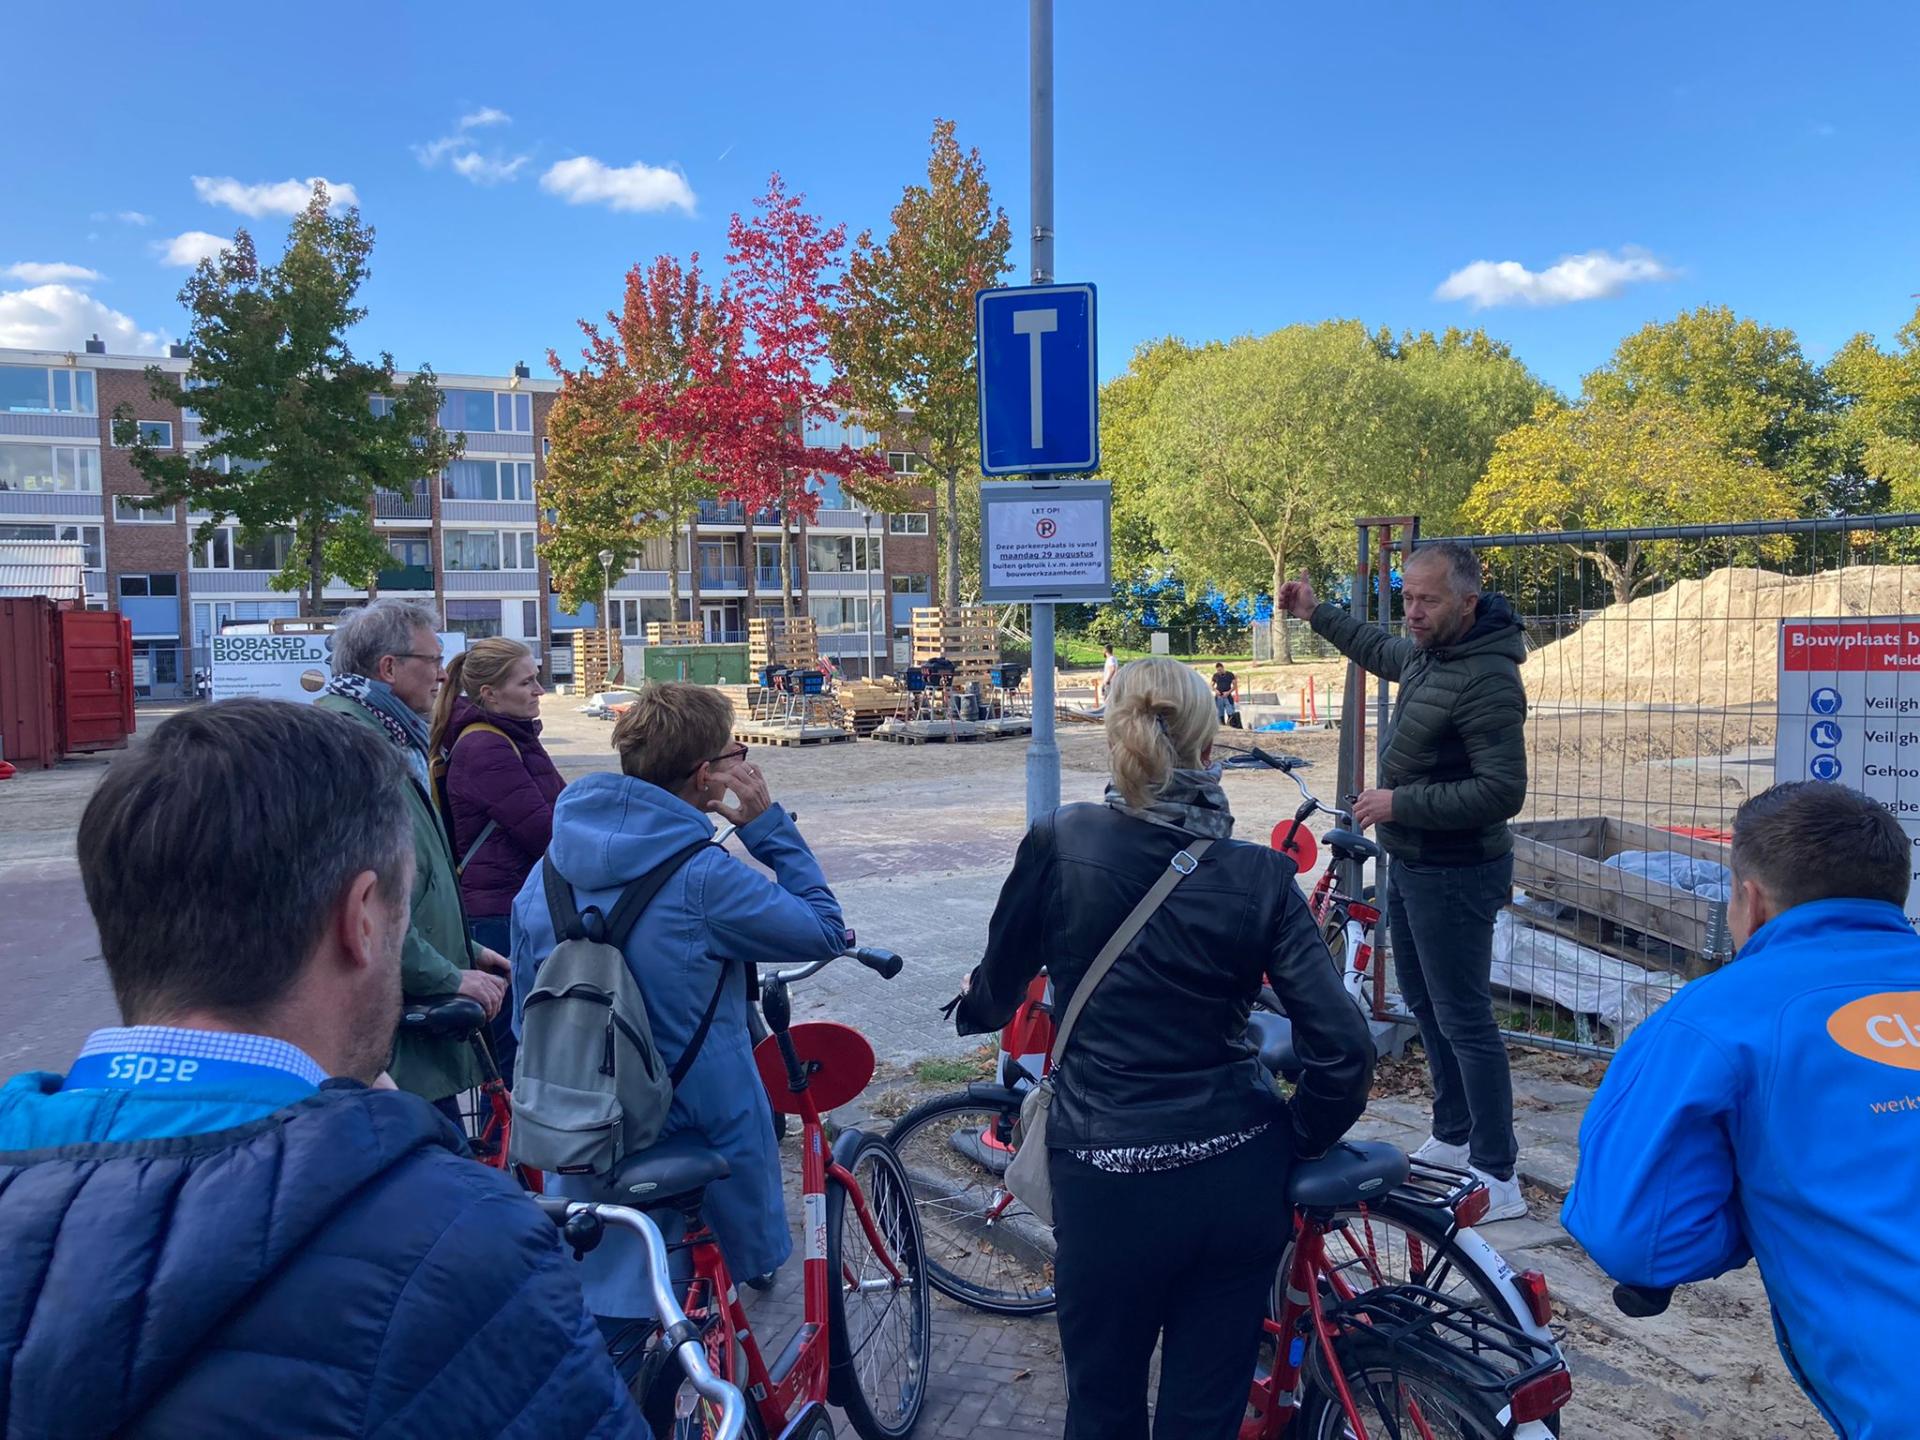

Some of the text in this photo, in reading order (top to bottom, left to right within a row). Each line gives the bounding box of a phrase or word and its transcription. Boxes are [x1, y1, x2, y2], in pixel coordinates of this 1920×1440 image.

[1016, 542, 1067, 551] parkeerplaats
[1076, 541, 1098, 549] vanaf
[1000, 550, 1094, 561] maandag 29 augustus
[1018, 562, 1046, 570] gebruik
[1070, 560, 1102, 569] aanvang
[1006, 570, 1088, 578] bouwwerkzaamheden.
[213, 637, 306, 650] BIOBASED
[1791, 631, 1901, 650] Bouwplaats
[213, 649, 323, 662] BOSCHVELD
[1883, 653, 1920, 666] Meld
[1865, 697, 1919, 713] Veiligh
[1865, 730, 1919, 747] Veiligh
[1864, 764, 1919, 778] Gehoo
[1866, 1013, 1920, 1048] Cl
[107, 1053, 199, 1085] aedes
[1870, 1095, 1920, 1114] werk
